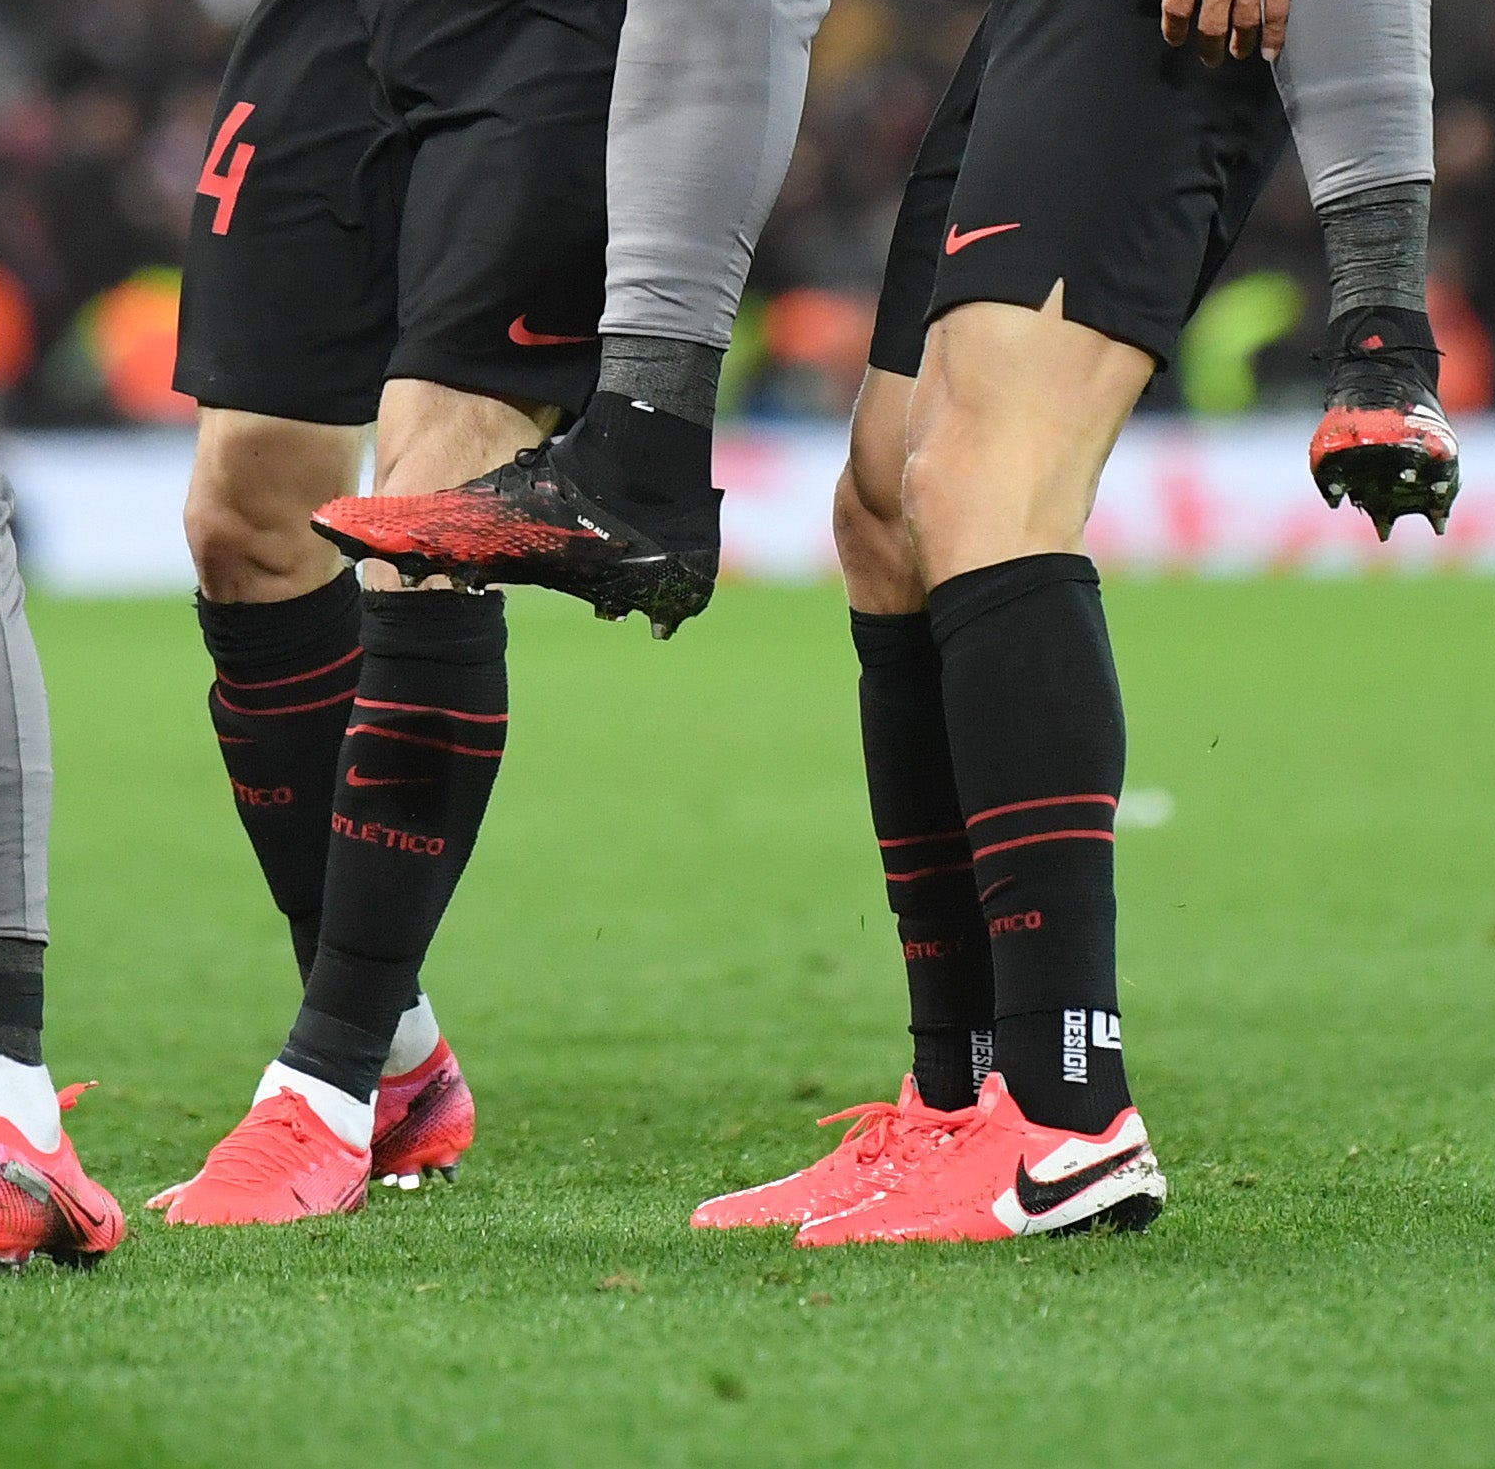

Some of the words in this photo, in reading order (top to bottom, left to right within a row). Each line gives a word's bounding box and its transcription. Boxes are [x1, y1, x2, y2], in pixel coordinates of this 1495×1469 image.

[196, 101, 256, 236] 4
[576, 514, 596, 530] LEO
[592, 526, 611, 541] ALE
